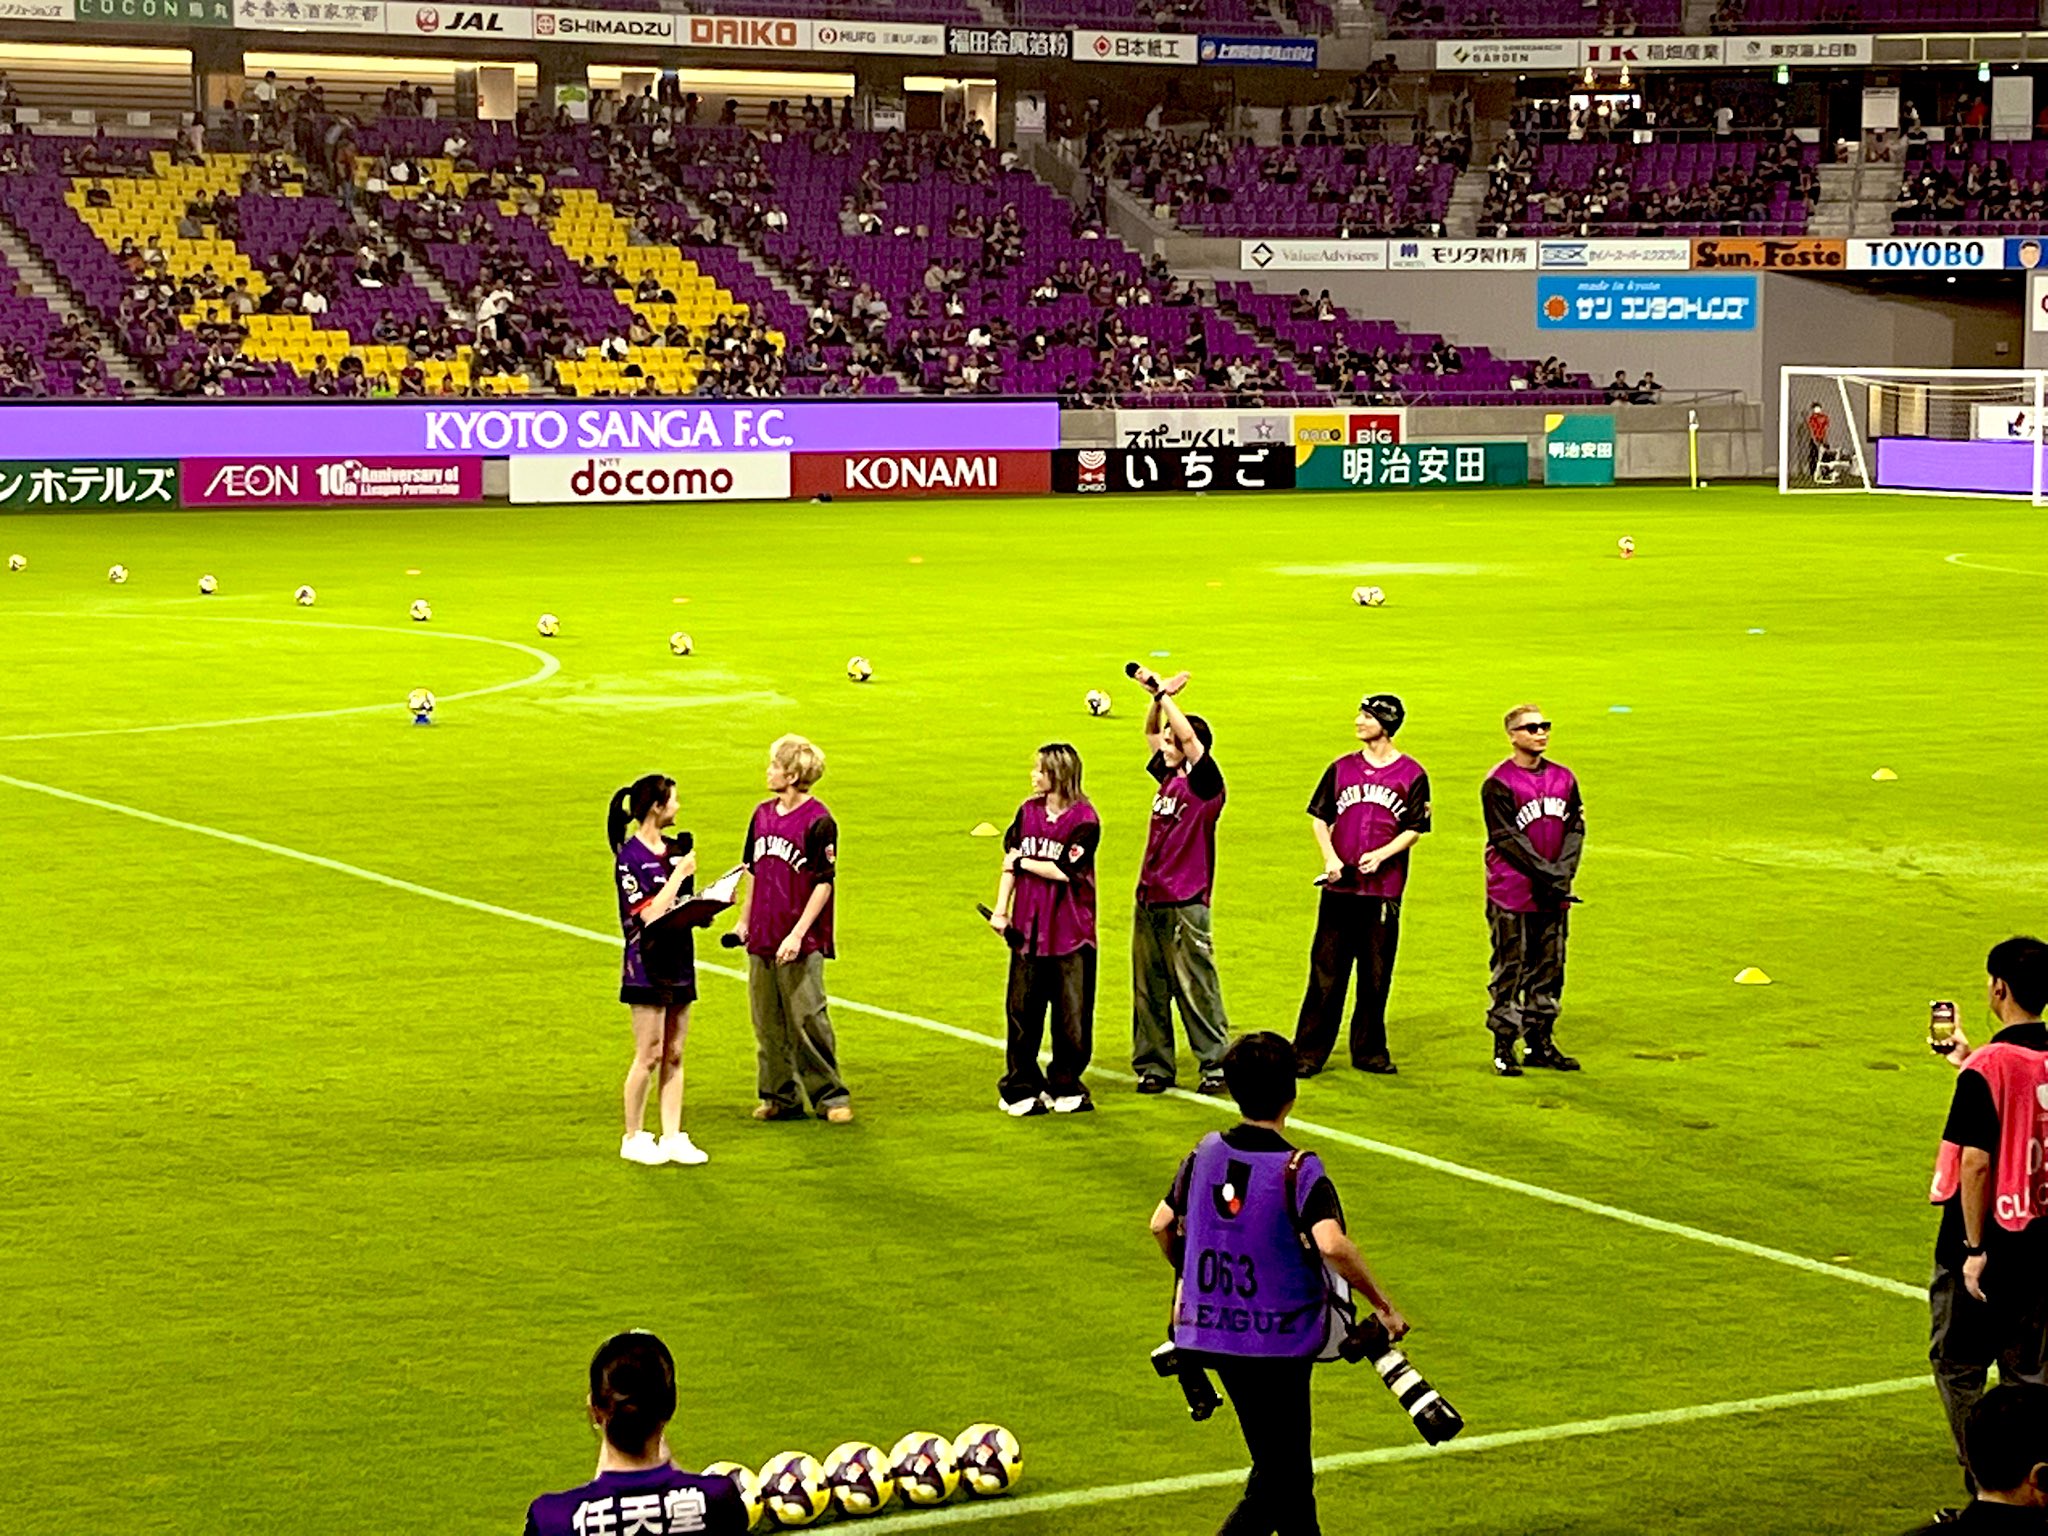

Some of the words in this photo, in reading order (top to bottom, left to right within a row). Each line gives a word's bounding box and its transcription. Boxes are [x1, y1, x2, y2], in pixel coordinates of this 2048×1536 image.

[445, 12, 503, 31] JAL
[558, 18, 672, 36] SHIMADZU
[690, 19, 797, 46] DAIKO
[840, 31, 876, 44] MUFG
[1115, 38, 1180, 59] 日本紙工
[1647, 44, 1720, 60] 稲畑産業
[1769, 43, 1857, 58] 東京海上日動
[1431, 247, 1528, 264] モリタ製作所
[1866, 241, 1984, 267] TOYOBO
[1576, 281, 1610, 291] made
[1612, 281, 1625, 291] in
[1626, 281, 1661, 293] kyoto
[1576, 296, 1613, 321] サン
[1621, 297, 1750, 321] コンタクトレンズ
[425, 409, 568, 450] KYOTO
[576, 409, 723, 449] SANGA
[733, 409, 794, 447] F.C.
[1124, 424, 1236, 448] スポーツくじ
[1548, 442, 1613, 459] 明治安田
[361, 466, 443, 484] Anniversary
[444, 465, 459, 483] of
[571, 459, 733, 496] docomo
[845, 456, 997, 489] KONAMI
[1125, 450, 1269, 489] いちご
[1342, 446, 1485, 485] 明治安田
[1197, 1248, 1258, 1298] 063
[572, 1487, 707, 1536] 任天堂
